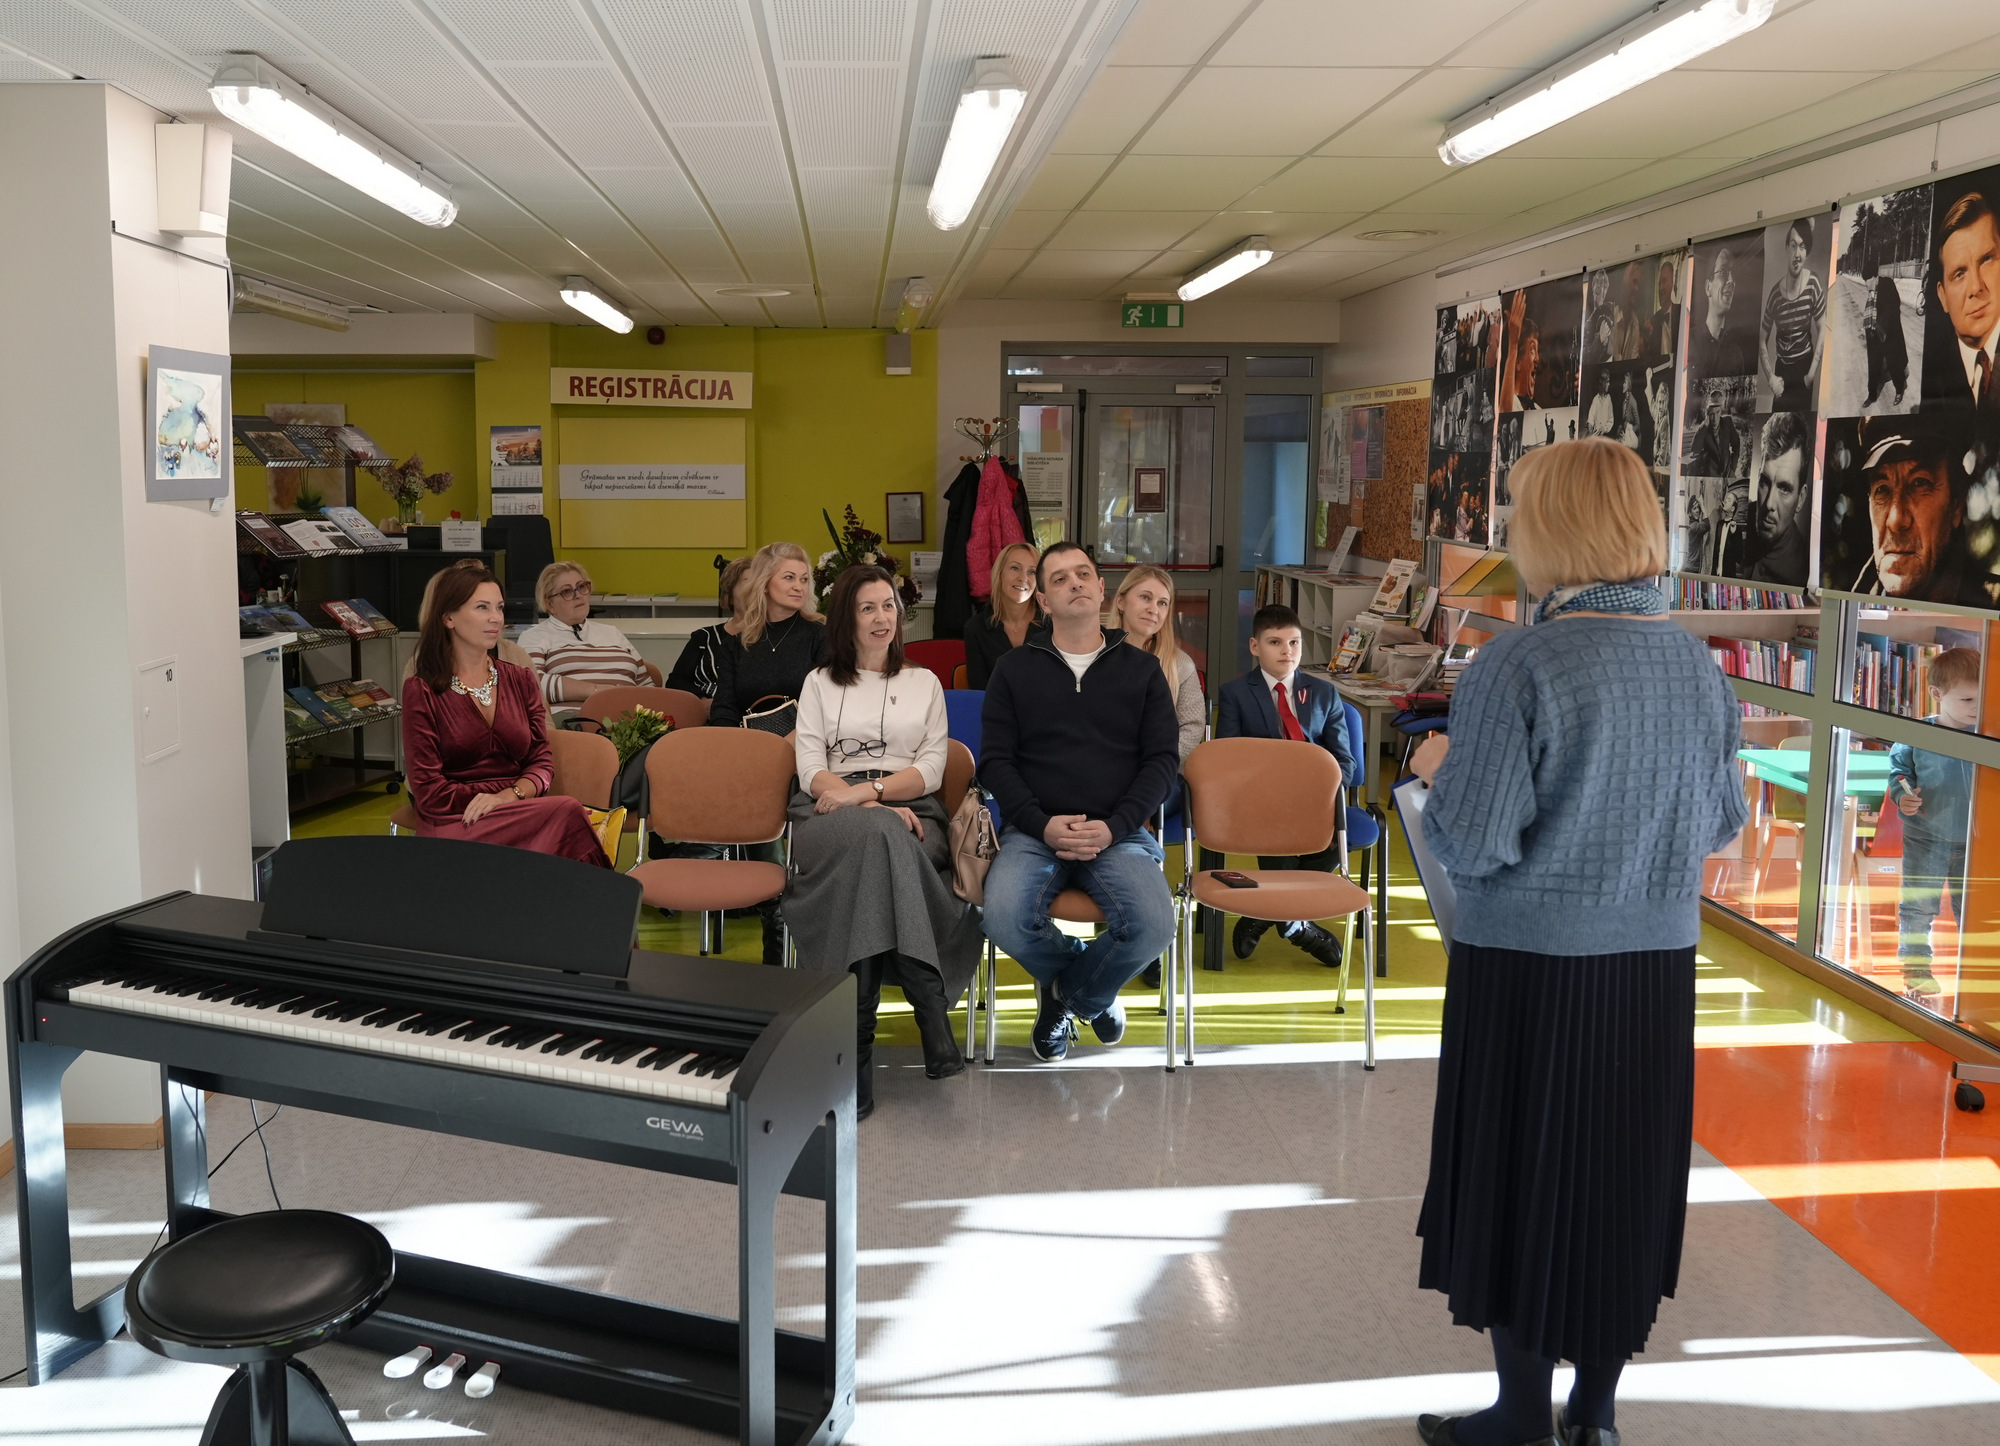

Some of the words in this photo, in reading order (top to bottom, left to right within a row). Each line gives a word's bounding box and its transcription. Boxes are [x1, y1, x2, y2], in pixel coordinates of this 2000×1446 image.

[569, 374, 734, 403] REĢISTRĀCIJA
[580, 469, 615, 482] Grāmatas
[627, 471, 644, 481] ziedi
[645, 470, 679, 481] daudziem
[680, 470, 711, 481] cilvēkiem
[712, 471, 720, 481] ir
[584, 482, 603, 492] tikpat
[604, 482, 646, 492] nepieciešami
[647, 480, 656, 490] kā
[1685, 600, 1690, 608] C
[1695, 600, 1700, 608] D
[1746, 600, 1751, 608] G
[1778, 600, 1783, 608] K
[1899, 707, 1904, 715] S
[646, 1117, 704, 1136] GEWA
